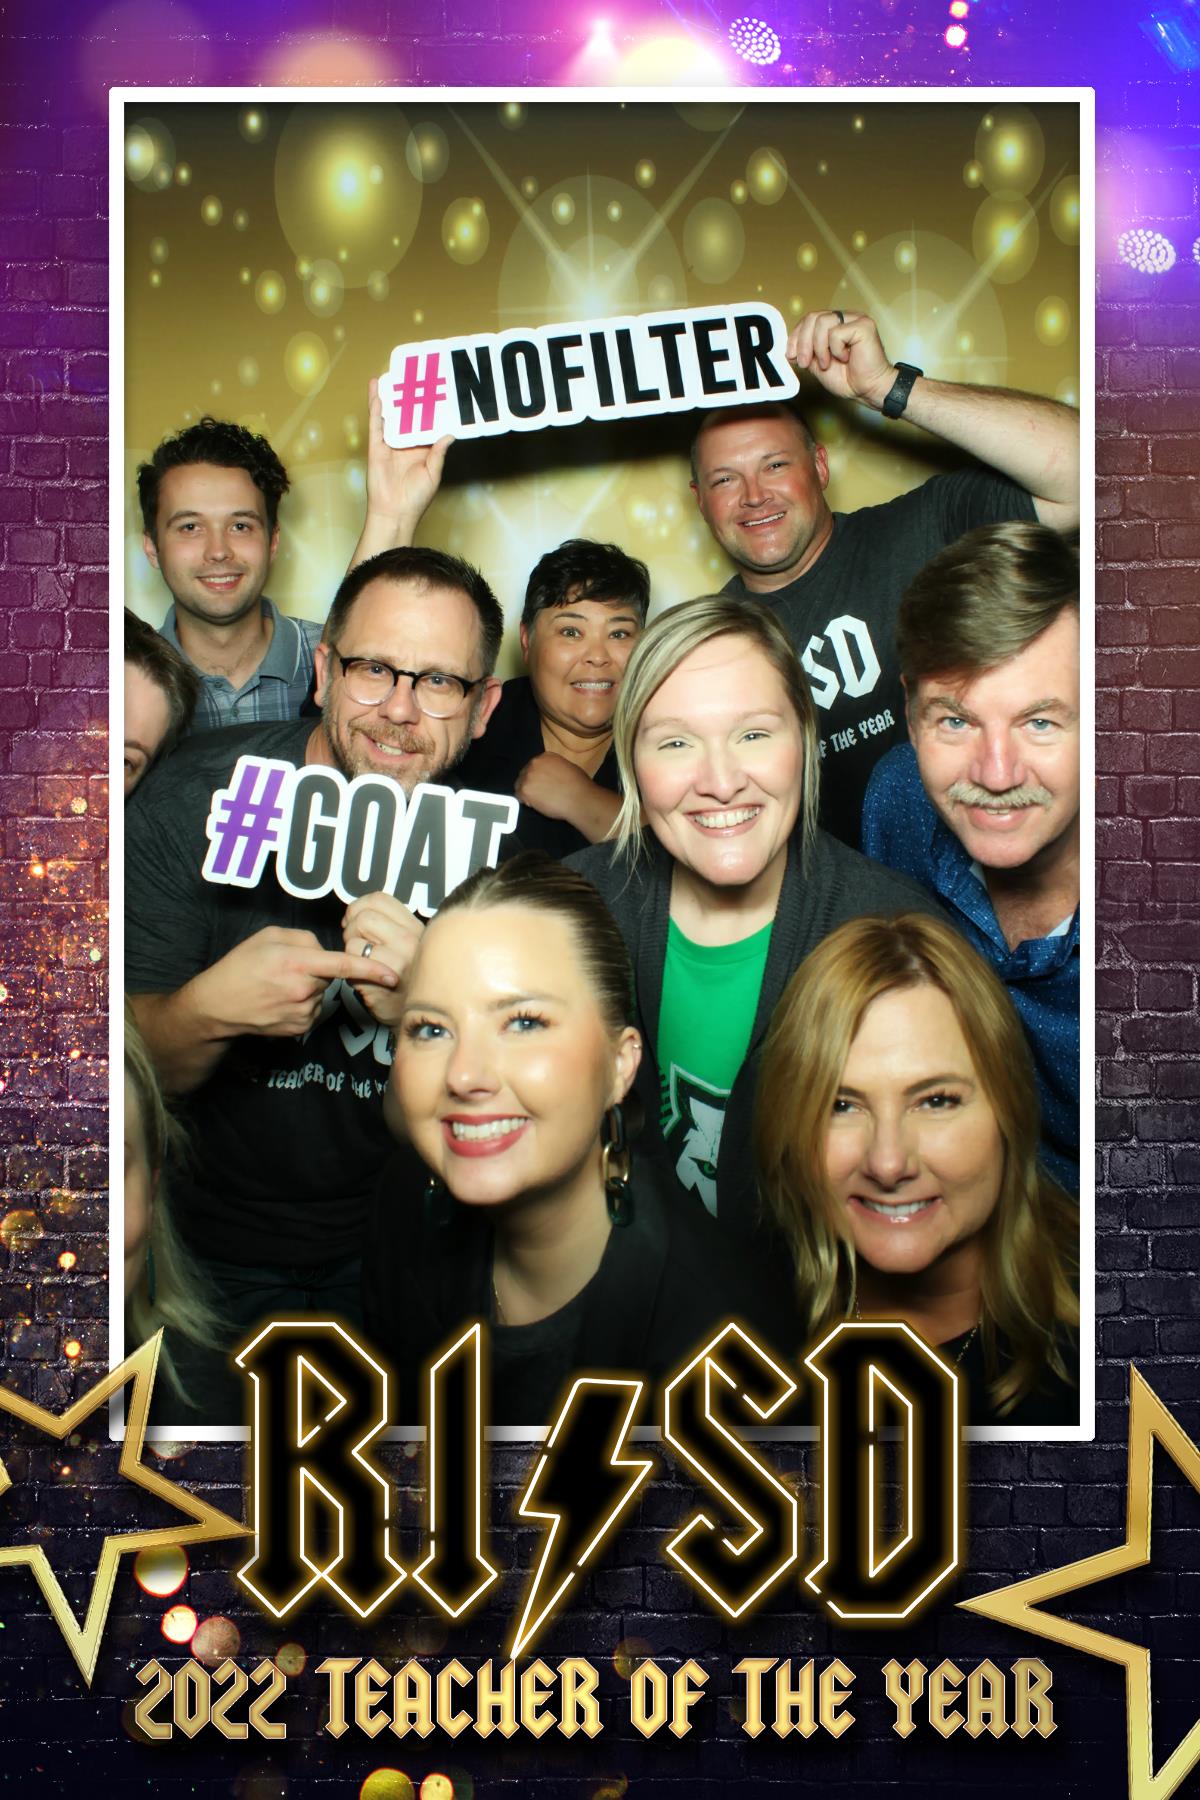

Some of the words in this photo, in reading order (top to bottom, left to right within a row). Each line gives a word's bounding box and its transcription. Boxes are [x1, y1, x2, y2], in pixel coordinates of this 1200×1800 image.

[393, 314, 786, 435] #NOFILTER
[830, 728, 857, 752] THE
[858, 709, 896, 739] YEAR
[211, 764, 510, 910] #GOAT
[267, 1062, 324, 1090] TEACER
[326, 1071, 346, 1093] OF
